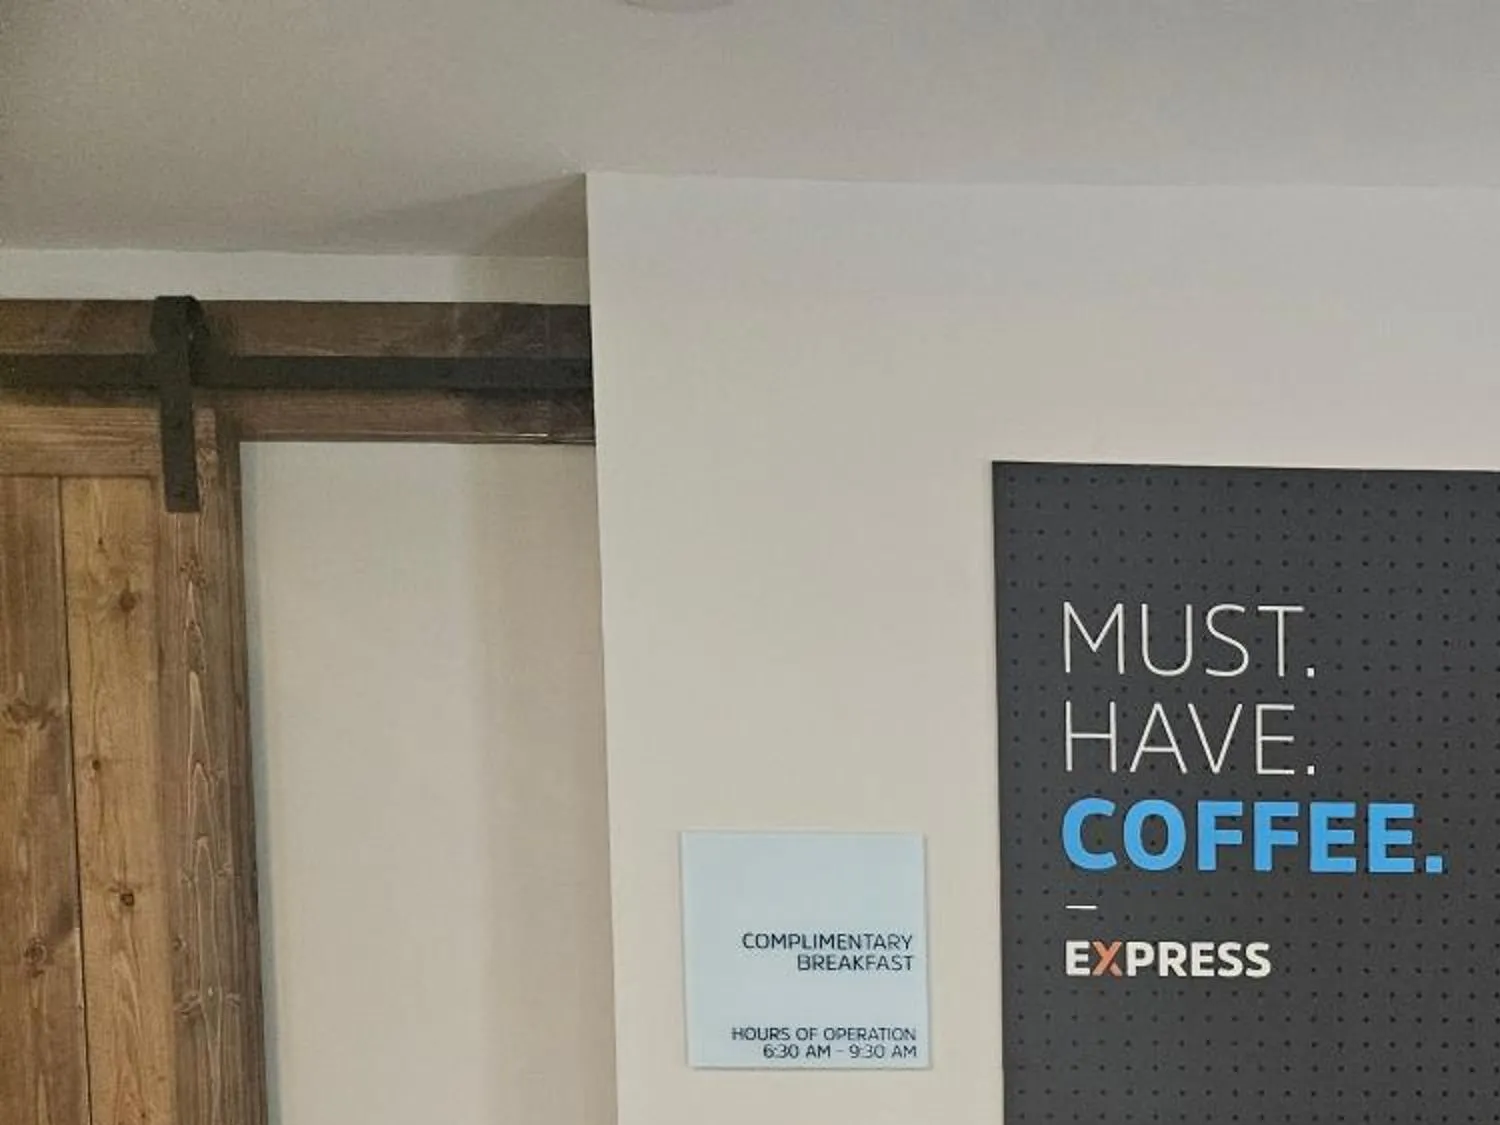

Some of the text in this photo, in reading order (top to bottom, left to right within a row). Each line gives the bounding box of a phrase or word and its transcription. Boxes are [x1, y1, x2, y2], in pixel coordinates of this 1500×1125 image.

[1063, 601, 1315, 678] MUST.
[1065, 701, 1315, 776] HAVE.
[1061, 797, 1443, 873] COFFEE.
[741, 932, 913, 950] COMPLIMENTARY
[797, 954, 914, 971] BREAKFAST
[1065, 940, 1272, 978] EXPRESS
[732, 1027, 916, 1041] HOURS OF OPERATION
[763, 1044, 799, 1059] 6:30
[805, 1044, 831, 1059] AM
[849, 1044, 885, 1059] 9:30
[890, 1044, 917, 1059] AM
